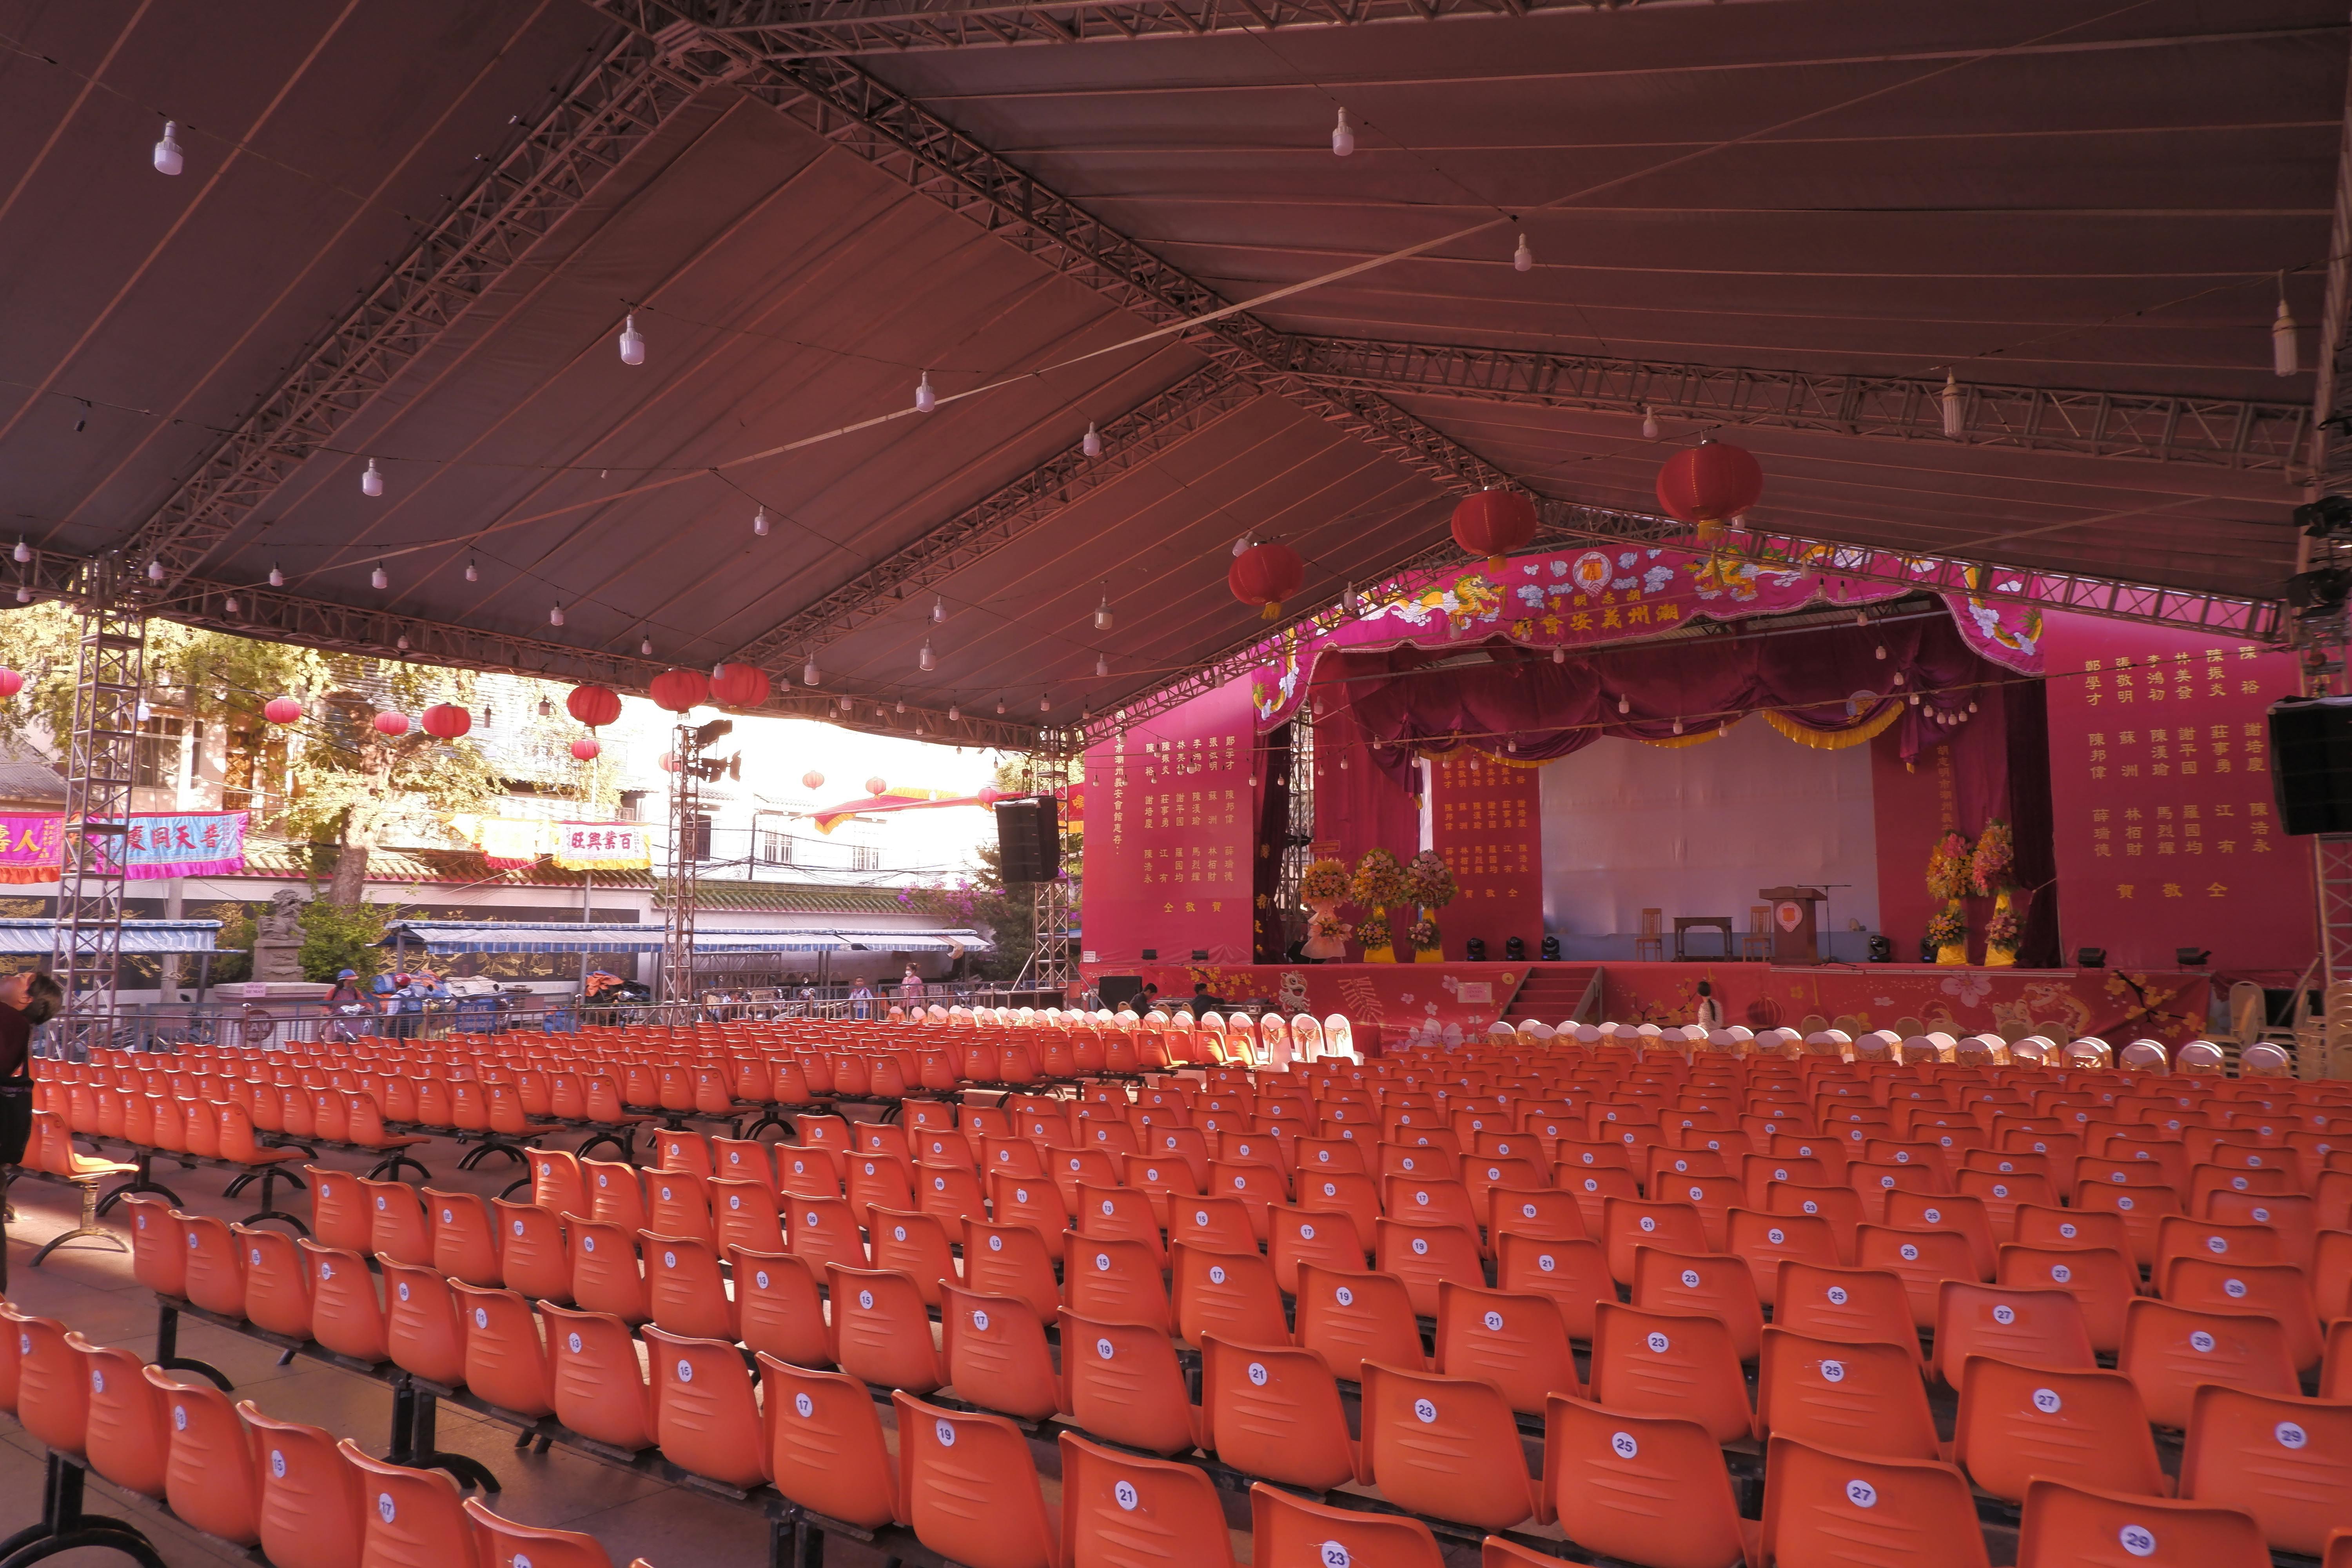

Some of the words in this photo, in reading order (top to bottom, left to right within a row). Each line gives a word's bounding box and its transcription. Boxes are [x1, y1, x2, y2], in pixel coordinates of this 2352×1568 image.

[1548, 589, 1641, 611] 胡志明市
[862, 1296, 870, 1305] 15
[1339, 1292, 1349, 1301] 19
[1998, 1310, 2011, 1319] 27
[1489, 1317, 1499, 1325] 21
[572, 1339, 579, 1348] 13
[1652, 1338, 1664, 1347] 23
[2195, 1337, 2210, 1347] 29
[1100, 1345, 1110, 1354] 19
[680, 1367, 689, 1376] 15
[1253, 1368, 1263, 1379] 21
[1826, 1366, 1840, 1376] 25
[799, 1400, 808, 1410] 17
[2038, 1395, 2054, 1406] 27
[1419, 1405, 1432, 1417] 23
[940, 1428, 951, 1440] 19
[2282, 1430, 2302, 1442] 29
[1617, 1439, 1633, 1452] 25
[274, 1459, 283, 1471] 15
[1120, 1489, 1132, 1502] 21
[1852, 1486, 1871, 1501] 27
[381, 1502, 391, 1515] 17
[2127, 1533, 2150, 1549] 29
[1328, 1551, 1345, 1564] 23
